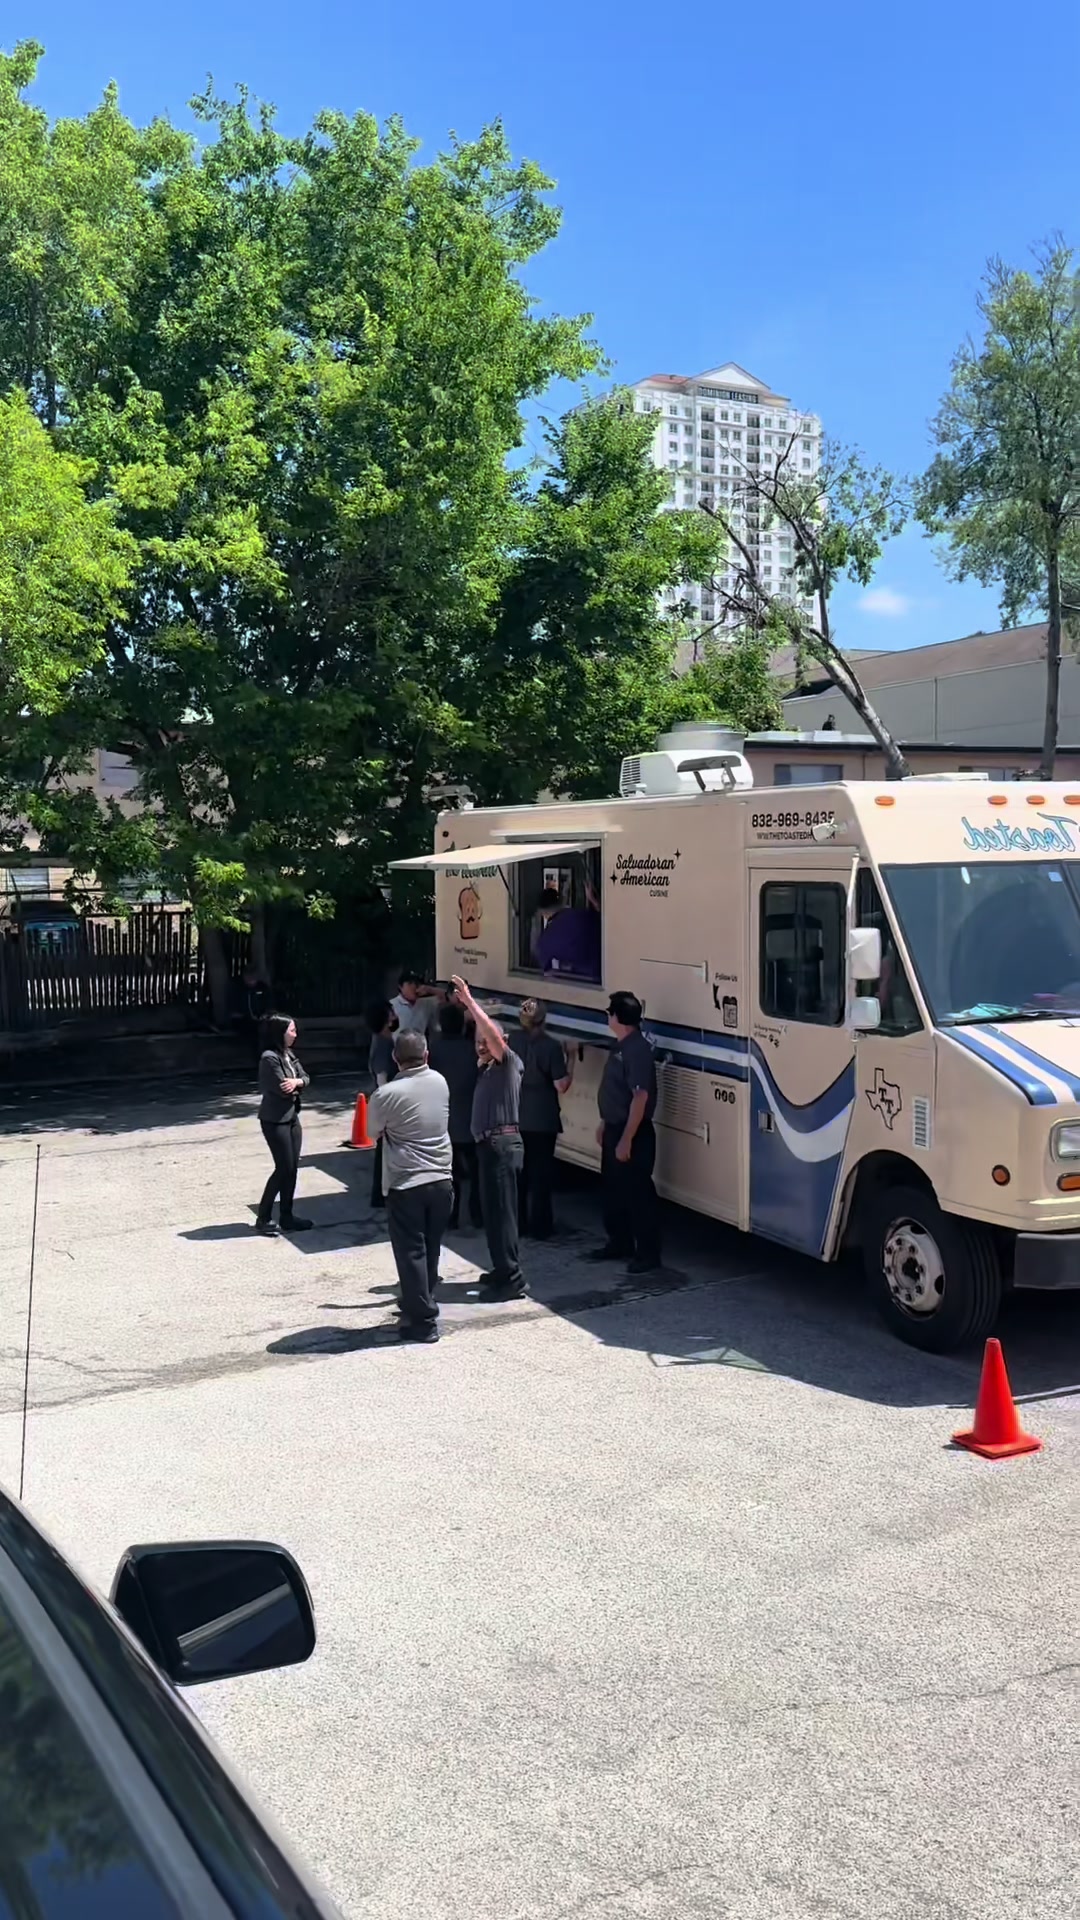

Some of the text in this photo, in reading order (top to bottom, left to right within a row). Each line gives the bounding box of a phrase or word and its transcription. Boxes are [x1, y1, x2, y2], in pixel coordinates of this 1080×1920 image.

[752, 811, 835, 828] 832-969-8435
[616, 853, 676, 870] Salvadoran
[620, 869, 670, 887] American
[649, 889, 669, 898] CUISINE
